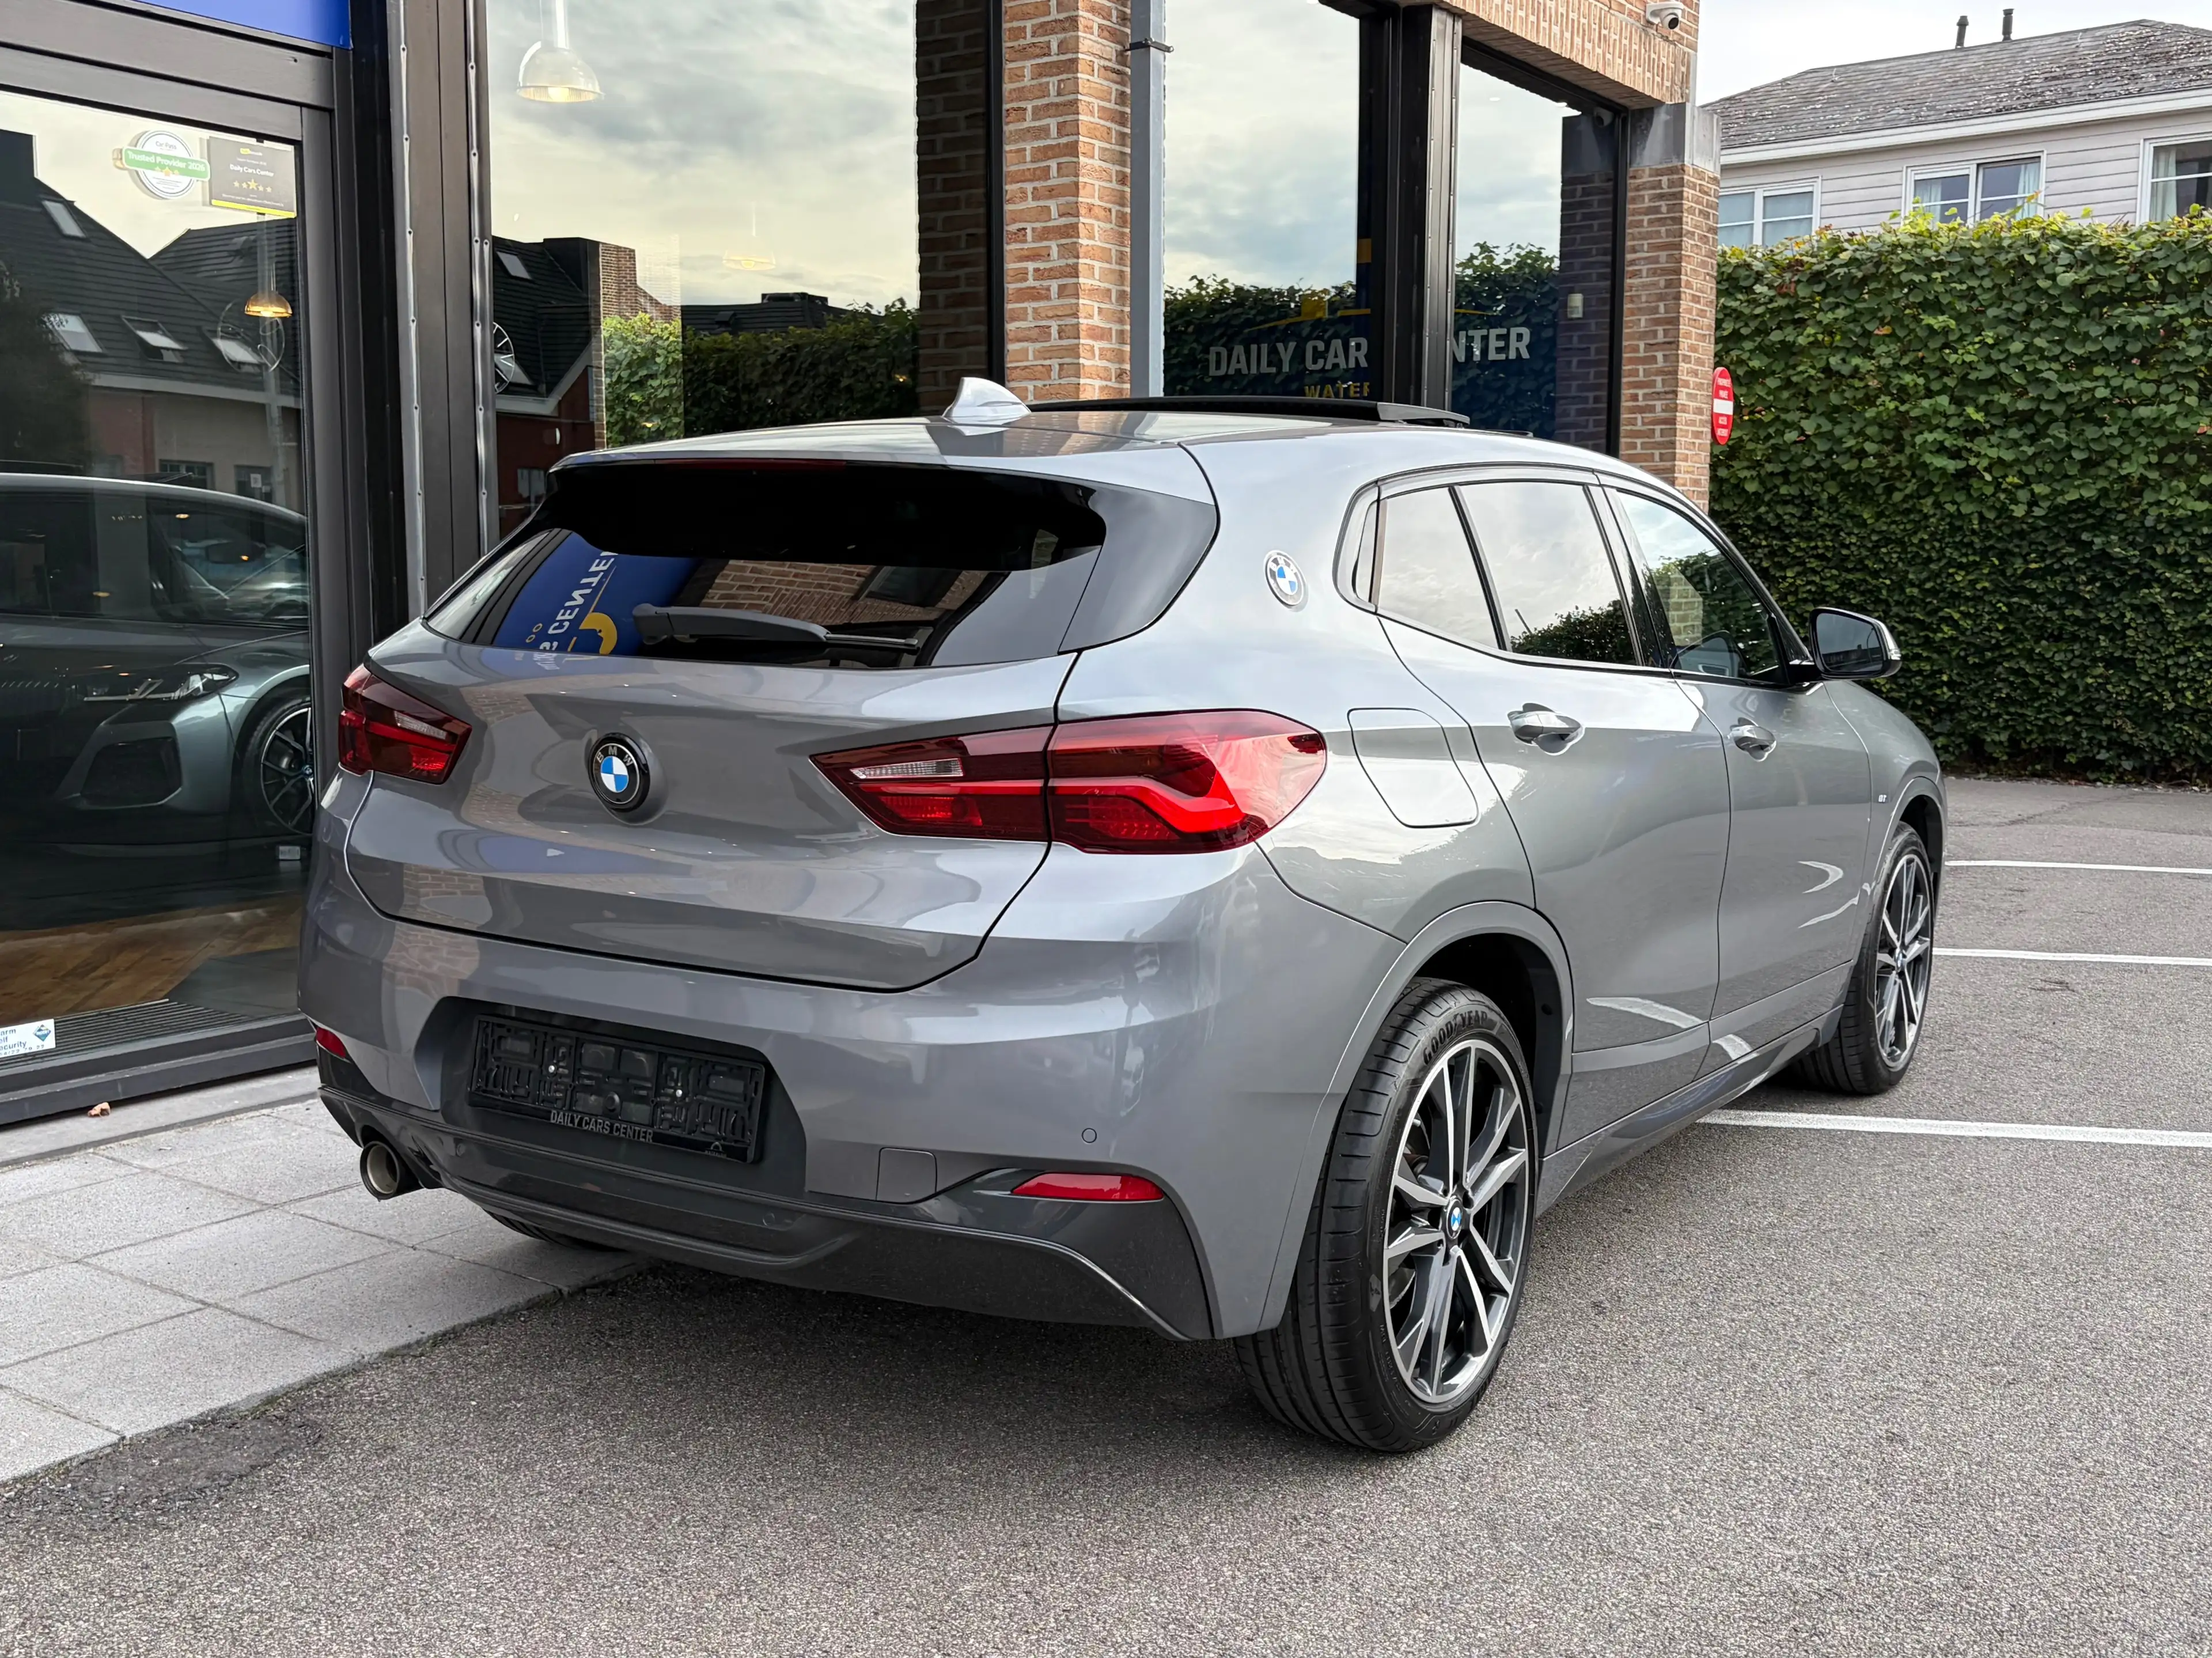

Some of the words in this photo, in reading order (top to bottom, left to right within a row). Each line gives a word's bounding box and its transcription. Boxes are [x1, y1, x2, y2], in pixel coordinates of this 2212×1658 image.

[127, 150, 156, 163] Trusted
[156, 155, 187, 169] Provider
[230, 164, 243, 173] Daily
[243, 166, 256, 174] Cars
[256, 169, 274, 177] Center
[1209, 342, 1297, 377] DAILY
[597, 746, 634, 767] BMW
[1423, 1010, 1488, 1065] GOODYEAR
[550, 1110, 581, 1127] DAILY
[582, 1117, 611, 1135] CARS
[613, 1123, 653, 1143] CENTER
